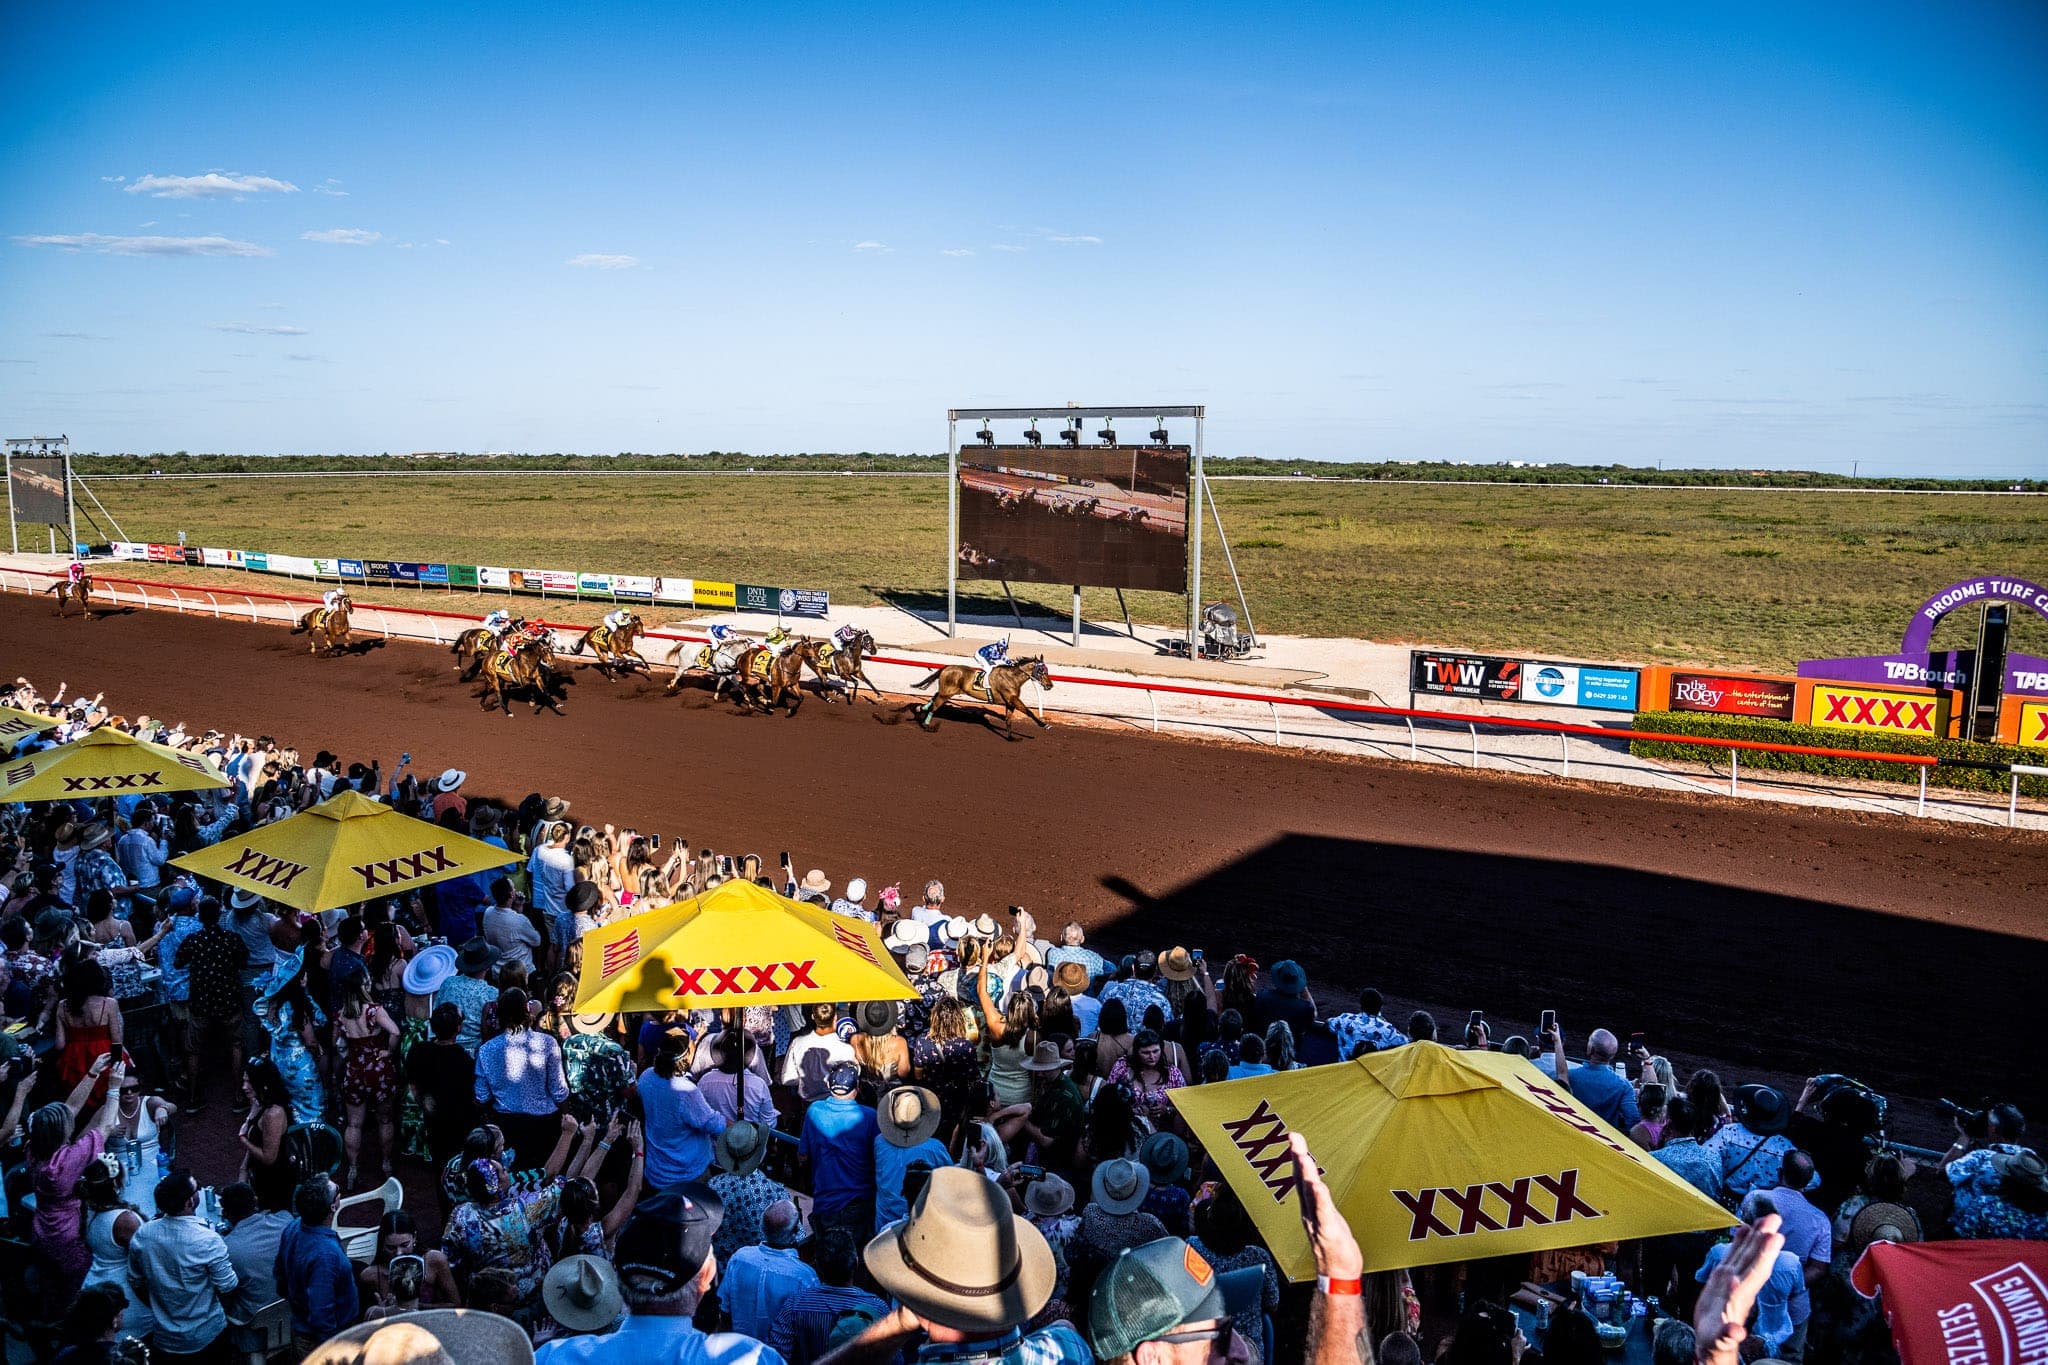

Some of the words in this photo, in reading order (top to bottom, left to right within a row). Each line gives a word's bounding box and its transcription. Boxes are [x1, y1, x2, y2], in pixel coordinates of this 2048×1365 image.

[694, 588, 718, 596] BROOKS
[720, 590, 734, 598] HIRE
[1924, 582, 1986, 620] BROOME
[1990, 581, 2035, 599] TURF
[1423, 661, 1486, 687] TWW
[1690, 680, 1706, 690] the
[1884, 661, 1967, 684] TABtouch
[1675, 683, 1724, 707] Roey
[1736, 699, 1758, 707] centre
[1767, 701, 1783, 709] town
[1744, 690, 1790, 701] entertainment
[1824, 694, 1936, 731] XXXX
[63, 771, 163, 792] XXXX
[223, 846, 309, 890] XXXX
[350, 845, 460, 890] XXXX
[601, 927, 641, 980] XXXX
[672, 959, 820, 997] XXXX
[1390, 1168, 1602, 1241] XXXX
[1937, 1302, 1989, 1365] SELTZE
[1992, 1276, 2048, 1365] SMIRNOF
